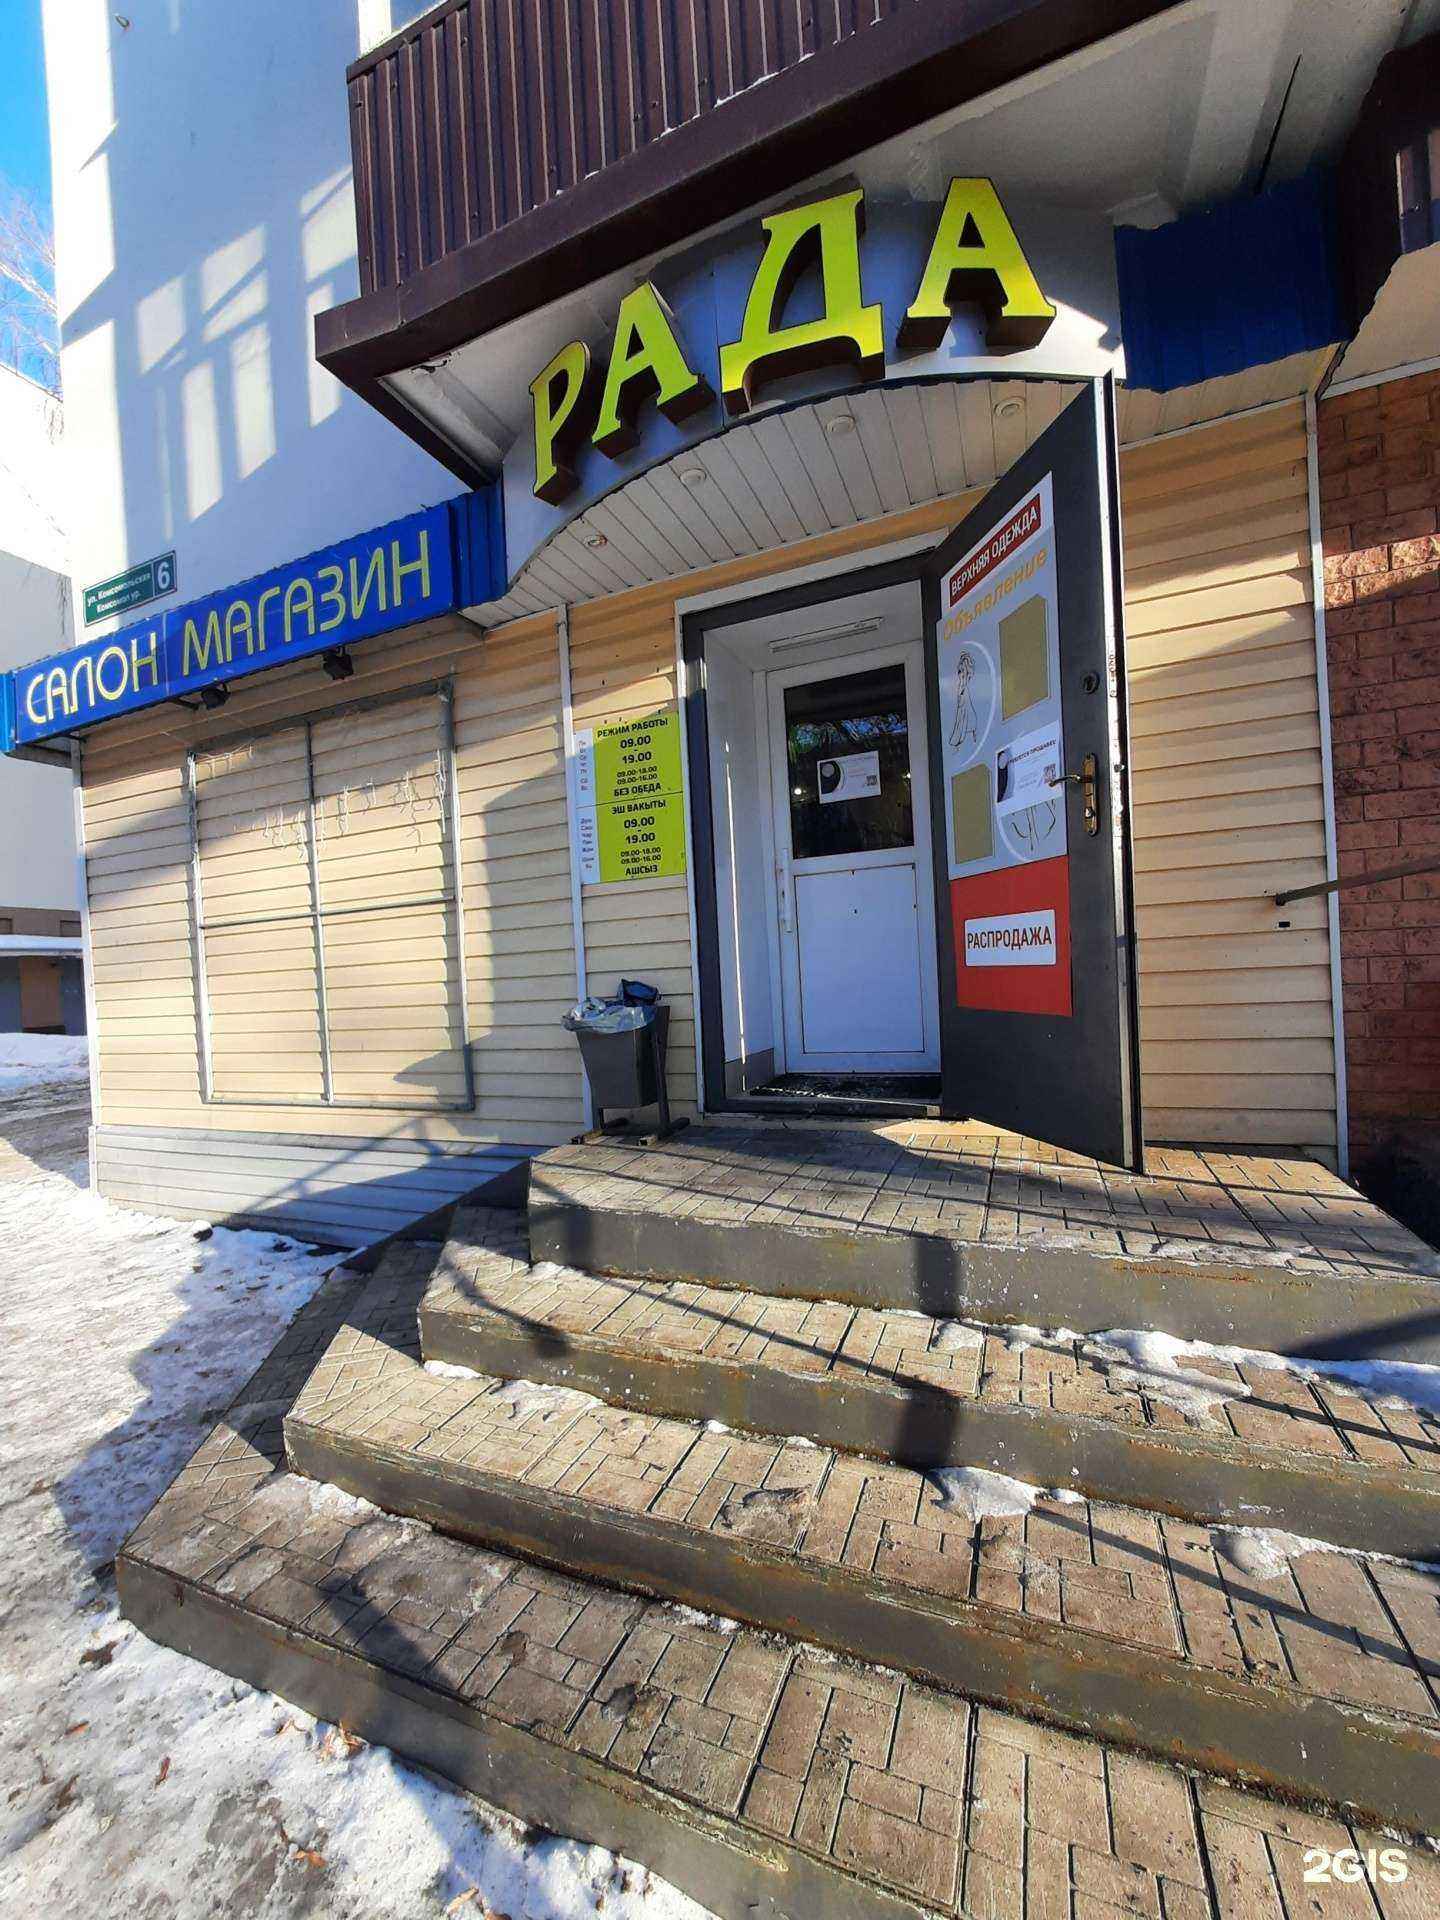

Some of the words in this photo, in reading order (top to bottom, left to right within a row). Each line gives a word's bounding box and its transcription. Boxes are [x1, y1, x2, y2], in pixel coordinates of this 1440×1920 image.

[529, 176, 1058, 498] РАДА
[951, 551, 990, 597] ВЕРХНЯЯ
[990, 505, 1038, 559] ОДЕЖДА
[157, 561, 171, 590] 6
[87, 595, 98, 607] ул.
[943, 548, 1049, 641] Объявление
[26, 632, 158, 724] САЛОН
[182, 530, 431, 676] МАГАЗИН
[597, 725, 631, 738] РЕЖИМ
[631, 717, 668, 731] РАБОТЫ
[619, 735, 651, 749] 09.00
[622, 751, 652, 764] 19.00
[613, 787, 629, 798] БЕЗ
[631, 782, 662, 795] ОБЕДА
[611, 804, 626, 815] ЭШ
[626, 799, 667, 814] ВАКЫТЫ
[623, 816, 655, 829] 09.00
[625, 832, 656, 844] 19.00
[625, 864, 659, 877] АШСЫЗ
[967, 925, 1053, 951] РАСПРОДАЖА
